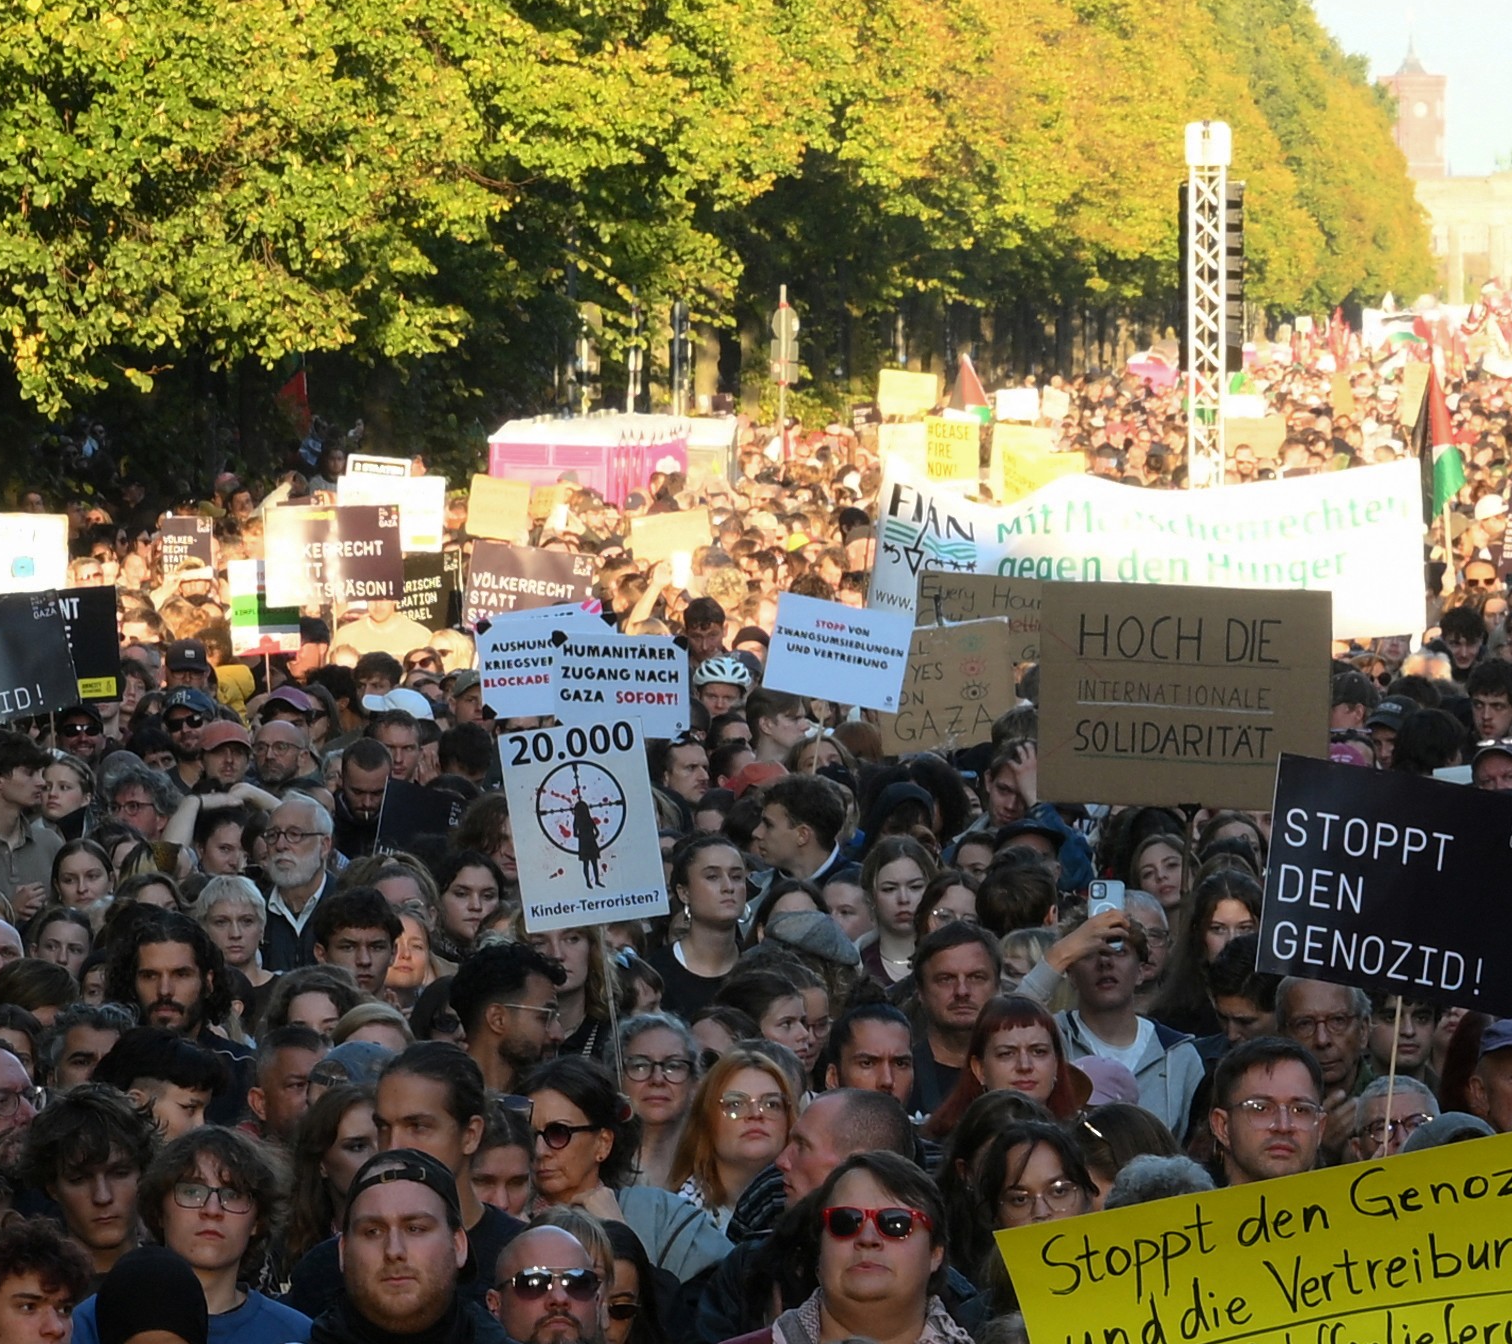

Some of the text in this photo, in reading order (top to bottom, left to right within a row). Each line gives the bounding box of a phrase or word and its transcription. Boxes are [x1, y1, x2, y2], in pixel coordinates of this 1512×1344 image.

[927, 441, 952, 459] FIRE
[927, 461, 959, 478] NOW!
[469, 592, 517, 608] STATT
[473, 572, 575, 599] VÖLKERRECHT
[777, 625, 904, 658] ZWANGSUMSIEDLUNGEN
[815, 619, 870, 637] STOPP VON
[1078, 613, 1282, 665] HOCH DIE
[563, 642, 676, 660] HUMANITÄRER
[787, 642, 888, 670] UND VERTREIBUNG
[483, 674, 550, 688] BLOCKADE
[561, 666, 679, 683] ZUGANG NACH
[560, 688, 679, 706] GAZA SOFORT!
[1077, 680, 1271, 711] INTERNATIONALE
[509, 721, 634, 766] 20.000
[1074, 718, 1273, 759] SOLIDARITÄT
[1283, 807, 1456, 873] STOPPT
[530, 890, 661, 919] Kinder-Terroristen?
[1277, 864, 1365, 916] DEN
[1271, 920, 1483, 998] GENOZID!
[1041, 1203, 1215, 1305] Stoppt
[1236, 1195, 1331, 1246] den
[1180, 1278, 1254, 1342] die
